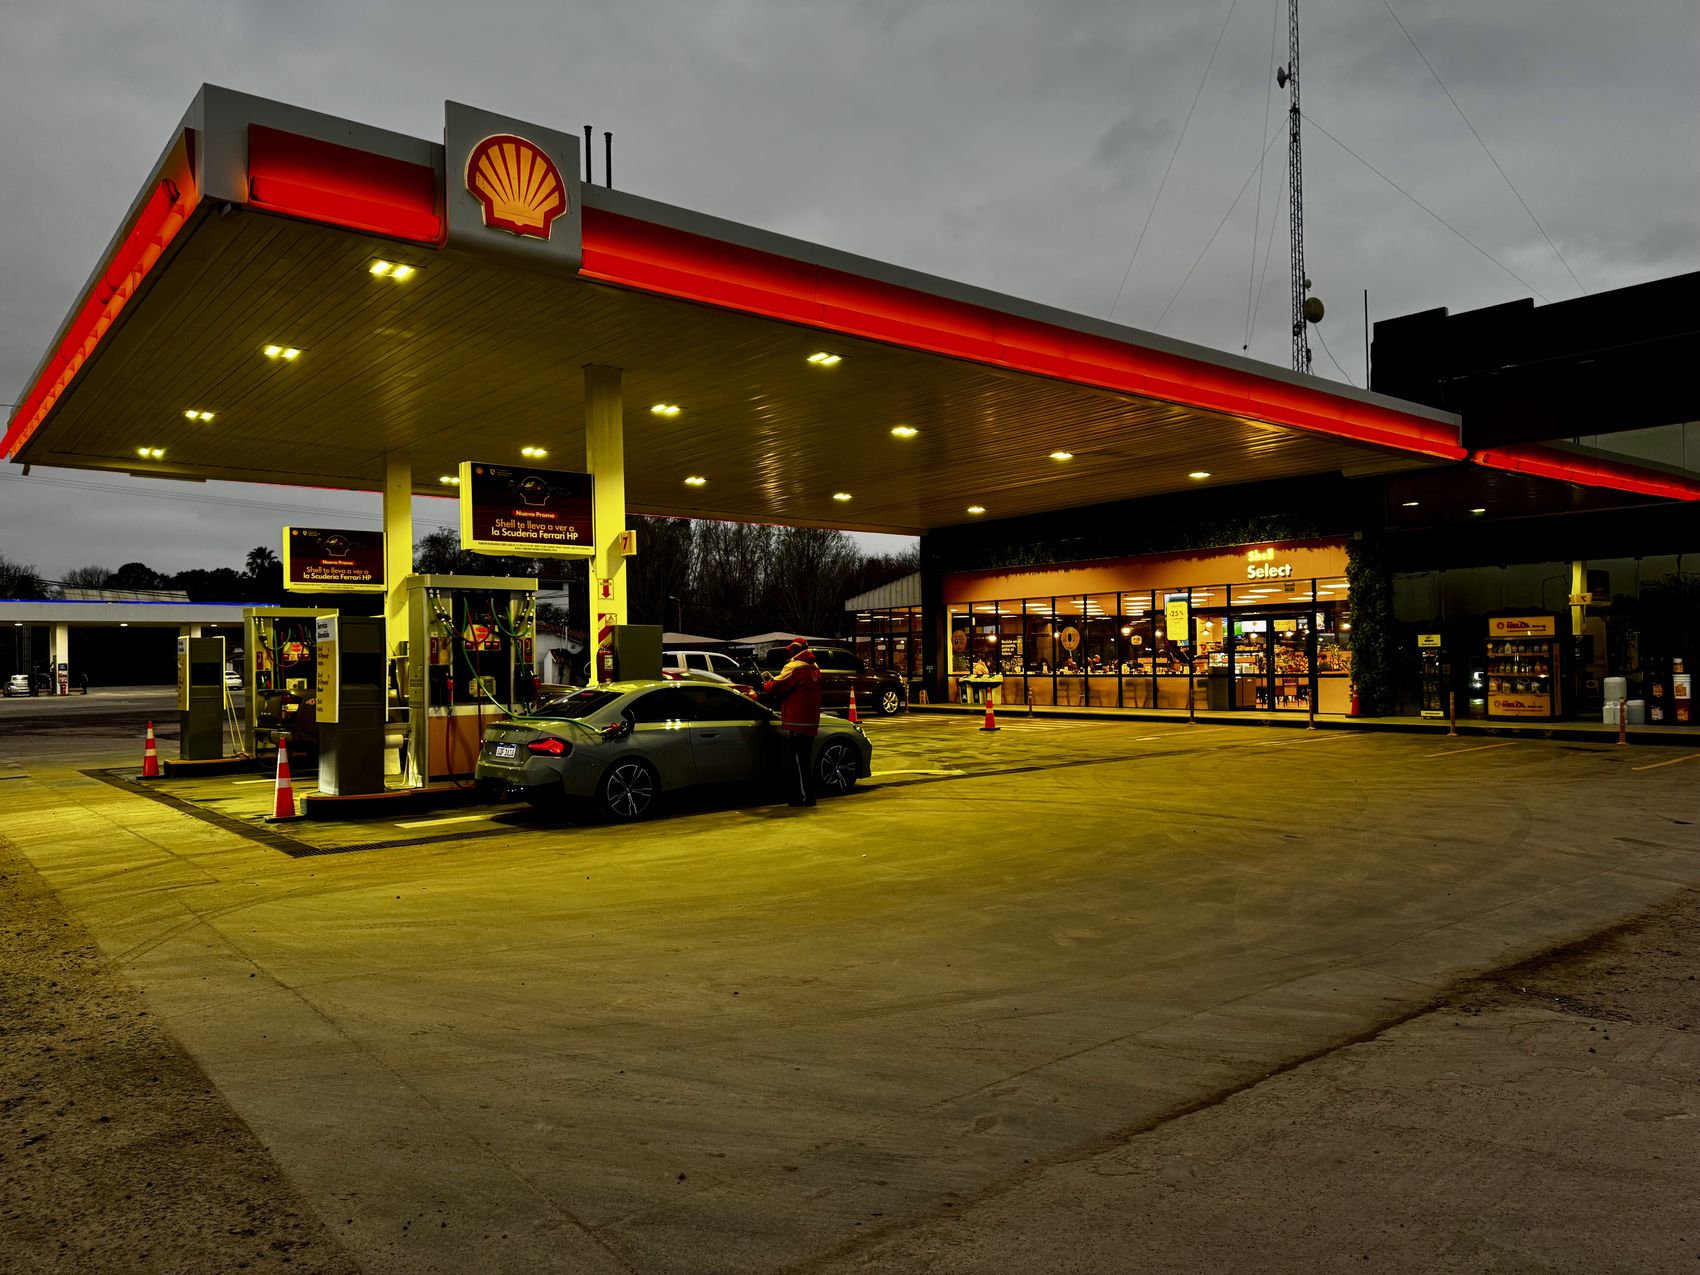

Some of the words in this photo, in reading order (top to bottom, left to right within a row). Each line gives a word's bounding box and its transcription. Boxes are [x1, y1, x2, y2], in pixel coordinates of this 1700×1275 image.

[496, 518, 515, 528] Shell
[517, 520, 525, 528] te
[527, 520, 546, 530] lleva
[492, 526, 499, 536] la
[502, 528, 538, 538] Scuderia
[539, 530, 565, 540] Ferrari
[567, 532, 578, 540] HP
[622, 536, 628, 550] 7
[1248, 548, 1274, 562] Shell
[1248, 563, 1292, 579] Select
